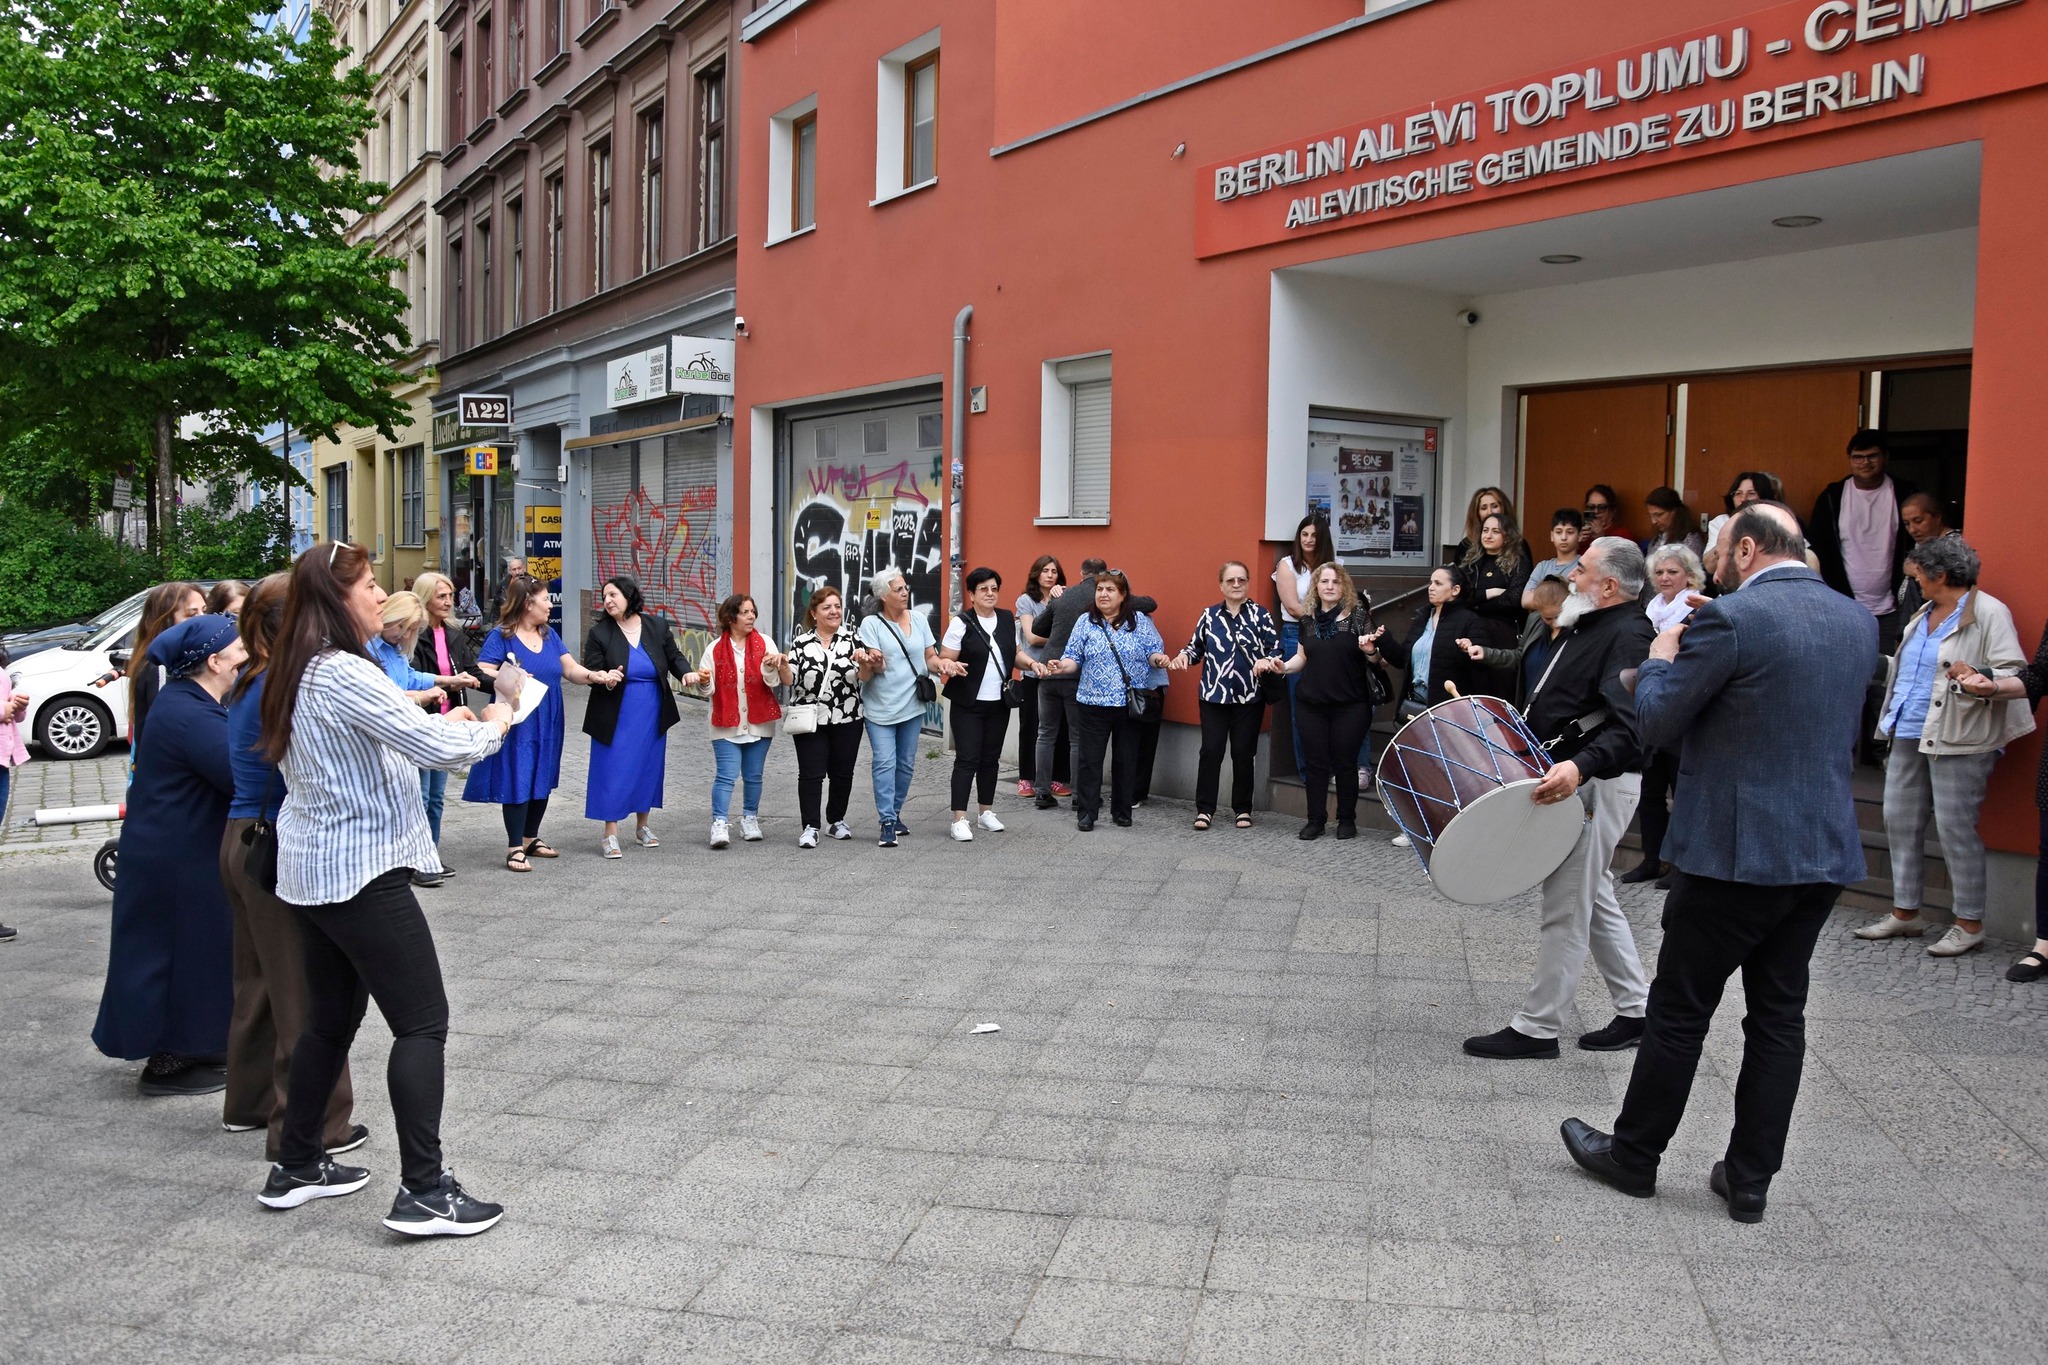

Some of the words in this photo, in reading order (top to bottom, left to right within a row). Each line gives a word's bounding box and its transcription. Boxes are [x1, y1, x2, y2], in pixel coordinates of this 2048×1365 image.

[1485, 27, 1749, 134] TOPLUMU
[1804, 0, 2024, 53] CE
[1284, 159, 1474, 229] ALEVITISCHE
[1476, 113, 1672, 187] GEMEINDE
[1673, 98, 1736, 147] ZU
[1742, 52, 1926, 131] BERLIN
[675, 367, 731, 382] KurbelDoc
[466, 402, 506, 419] A22
[434, 415, 459, 446] Atelier
[1363, 454, 1382, 467] ONE
[547, 592, 562, 603] TM
